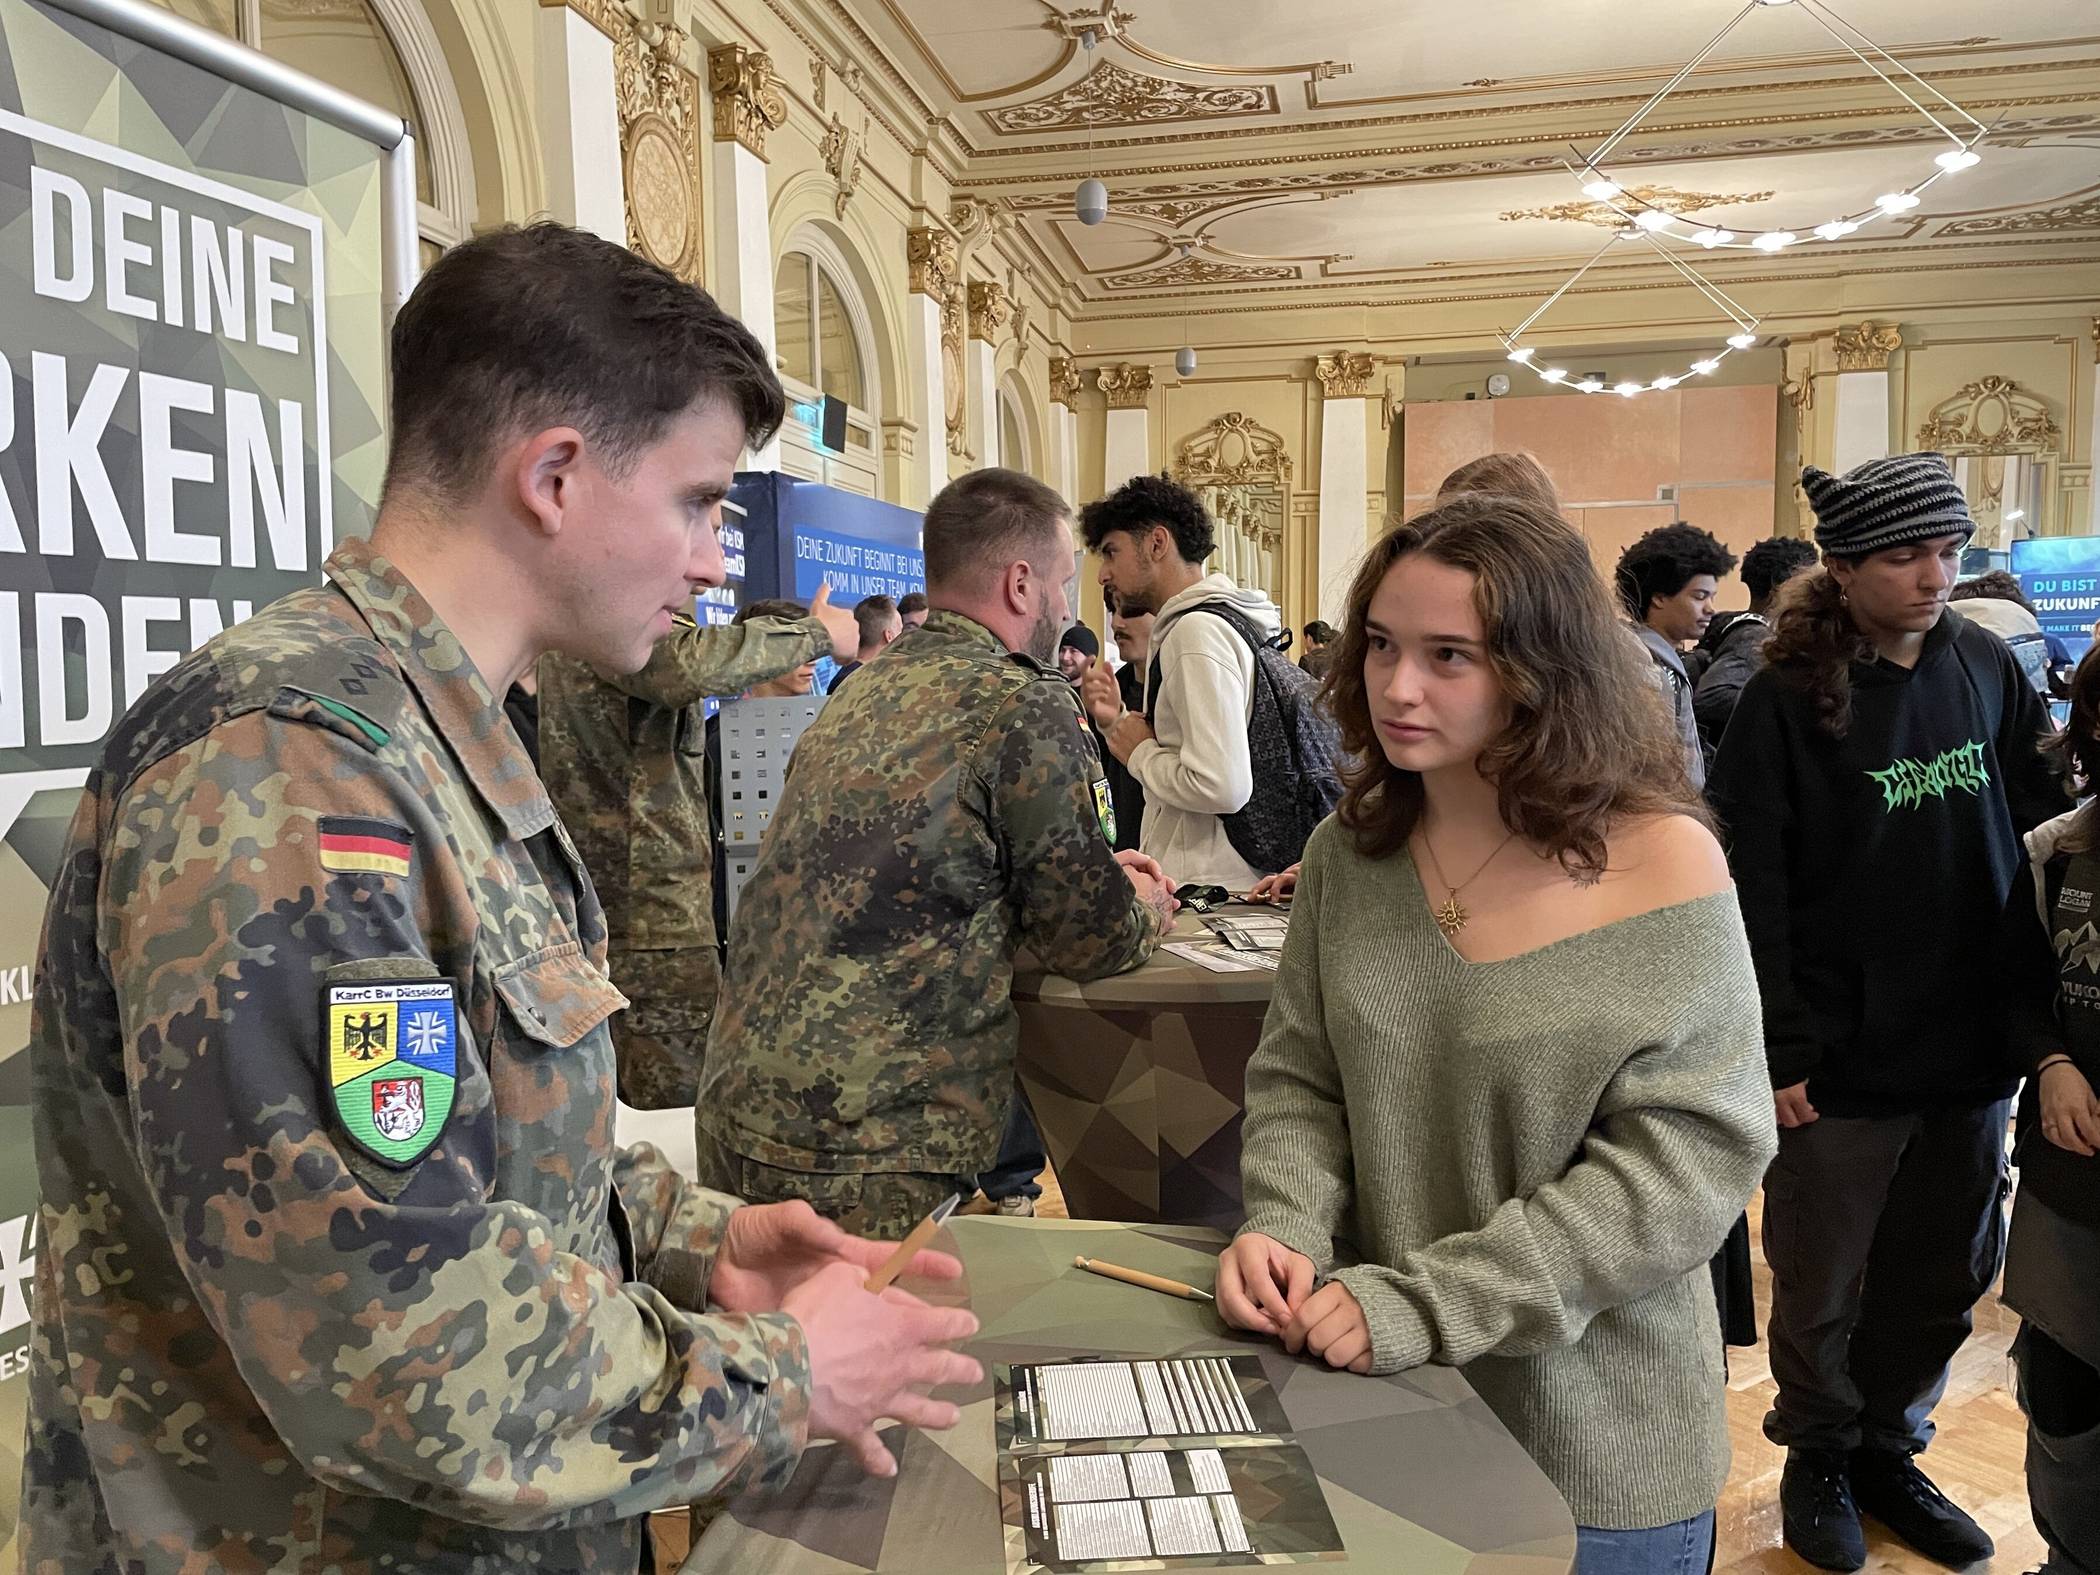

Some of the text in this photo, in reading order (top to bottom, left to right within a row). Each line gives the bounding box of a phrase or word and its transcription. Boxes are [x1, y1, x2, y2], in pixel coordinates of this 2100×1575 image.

[31, 165, 298, 354] DEINE
[797, 535, 823, 561] DEINE
[826, 541, 862, 567] ZUKUNFT
[864, 549, 895, 572] BEGINNT
[897, 555, 908, 574] BEI
[823, 570, 849, 593] KOMM
[851, 573, 860, 593] IN
[861, 576, 886, 596] UNSER
[2033, 579, 2097, 593] DU BIST
[2061, 887, 2093, 900] MOUNT
[2060, 895, 2091, 907] LOGAN
[376, 989, 392, 999] Bw
[397, 986, 449, 998] Düsseldorf
